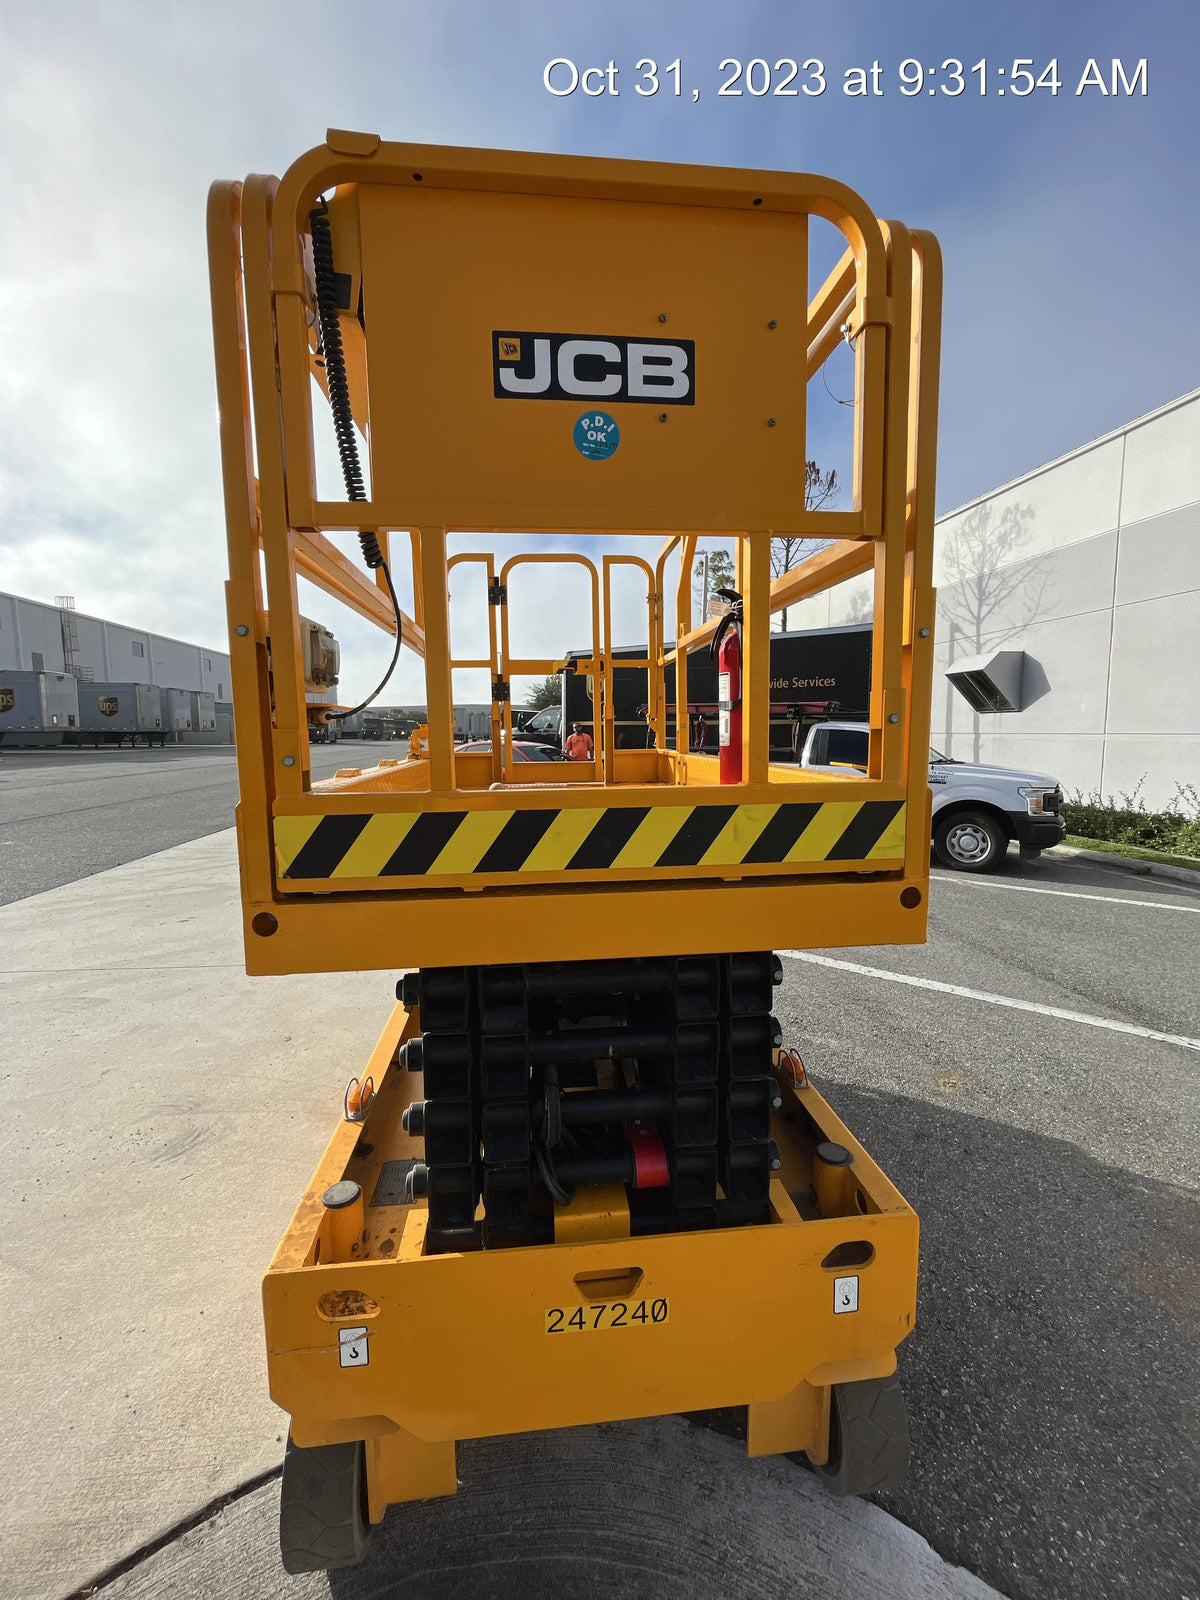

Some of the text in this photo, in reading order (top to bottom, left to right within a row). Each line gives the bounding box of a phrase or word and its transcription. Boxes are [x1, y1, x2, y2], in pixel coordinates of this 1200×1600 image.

[499, 338, 690, 398] JCB
[587, 430, 607, 442] OK
[791, 676, 836, 688] Services
[0, 694, 14, 710] ps
[99, 702, 118, 714] ups
[546, 1297, 668, 1333] 247240
